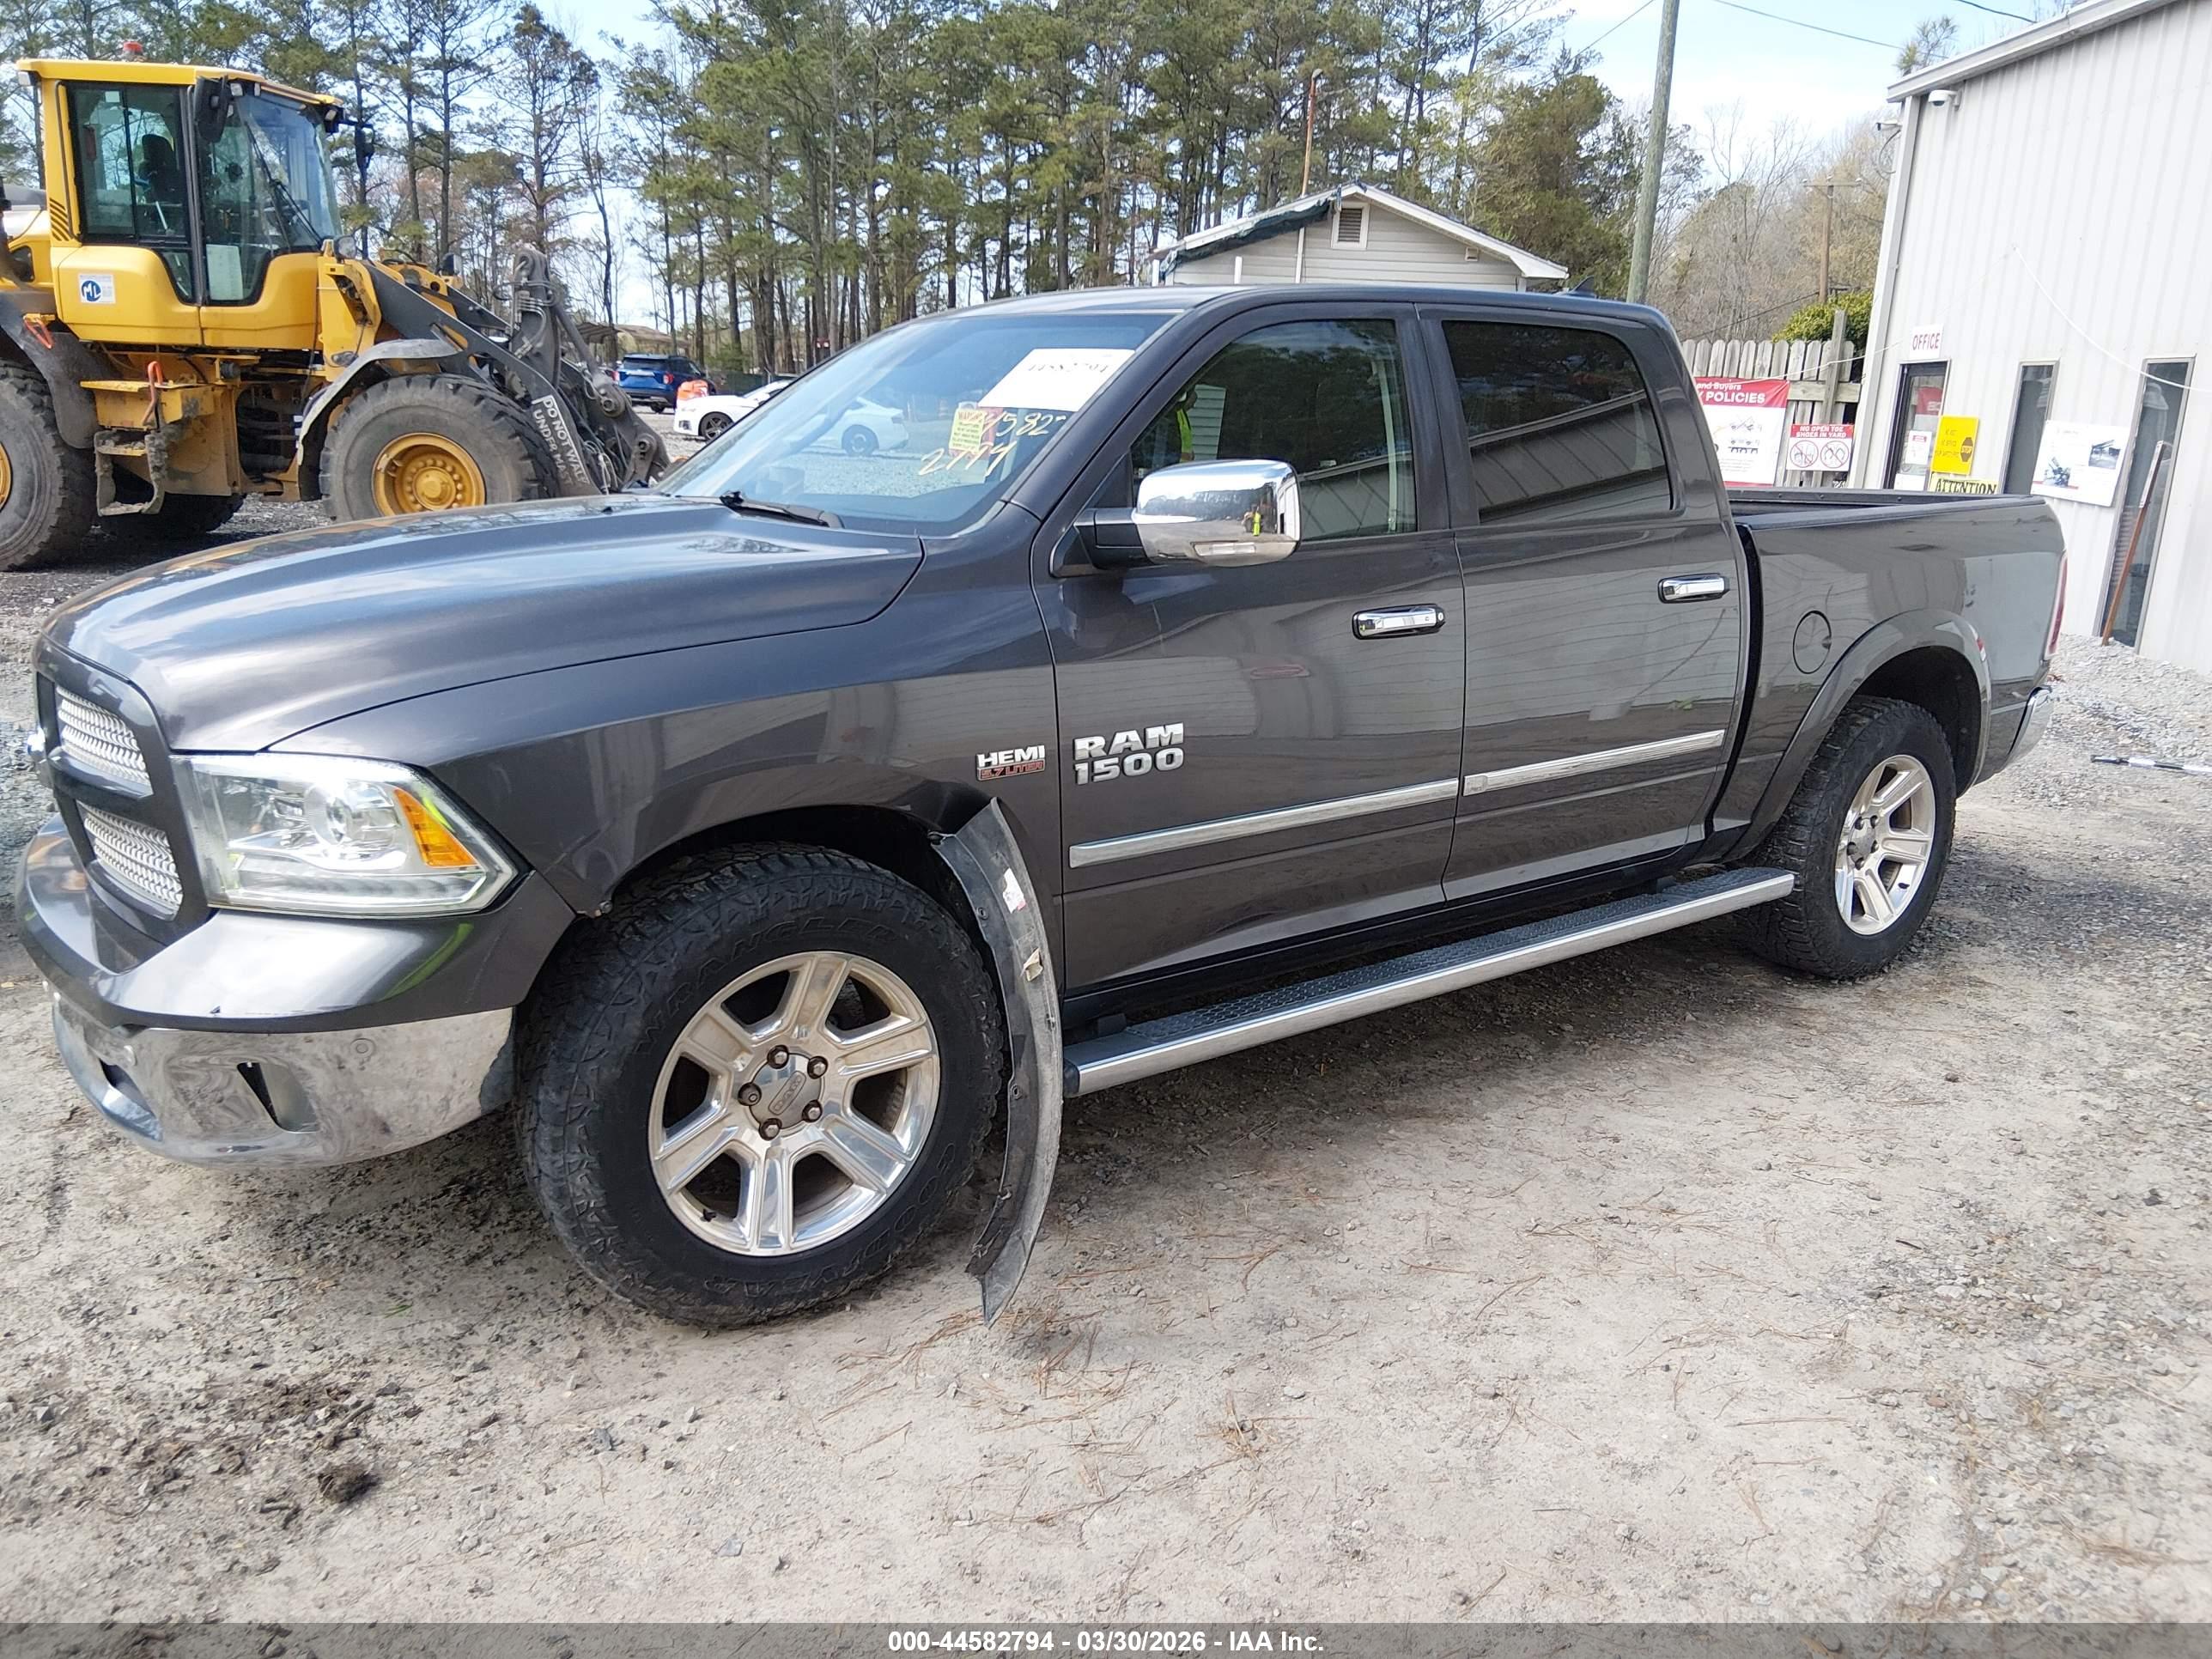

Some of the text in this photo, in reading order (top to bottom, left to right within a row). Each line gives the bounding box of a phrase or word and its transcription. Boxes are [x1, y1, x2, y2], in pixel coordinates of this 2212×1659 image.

[1912, 332, 1941, 351] OFFICE
[1713, 382, 1741, 392] Buyers
[1705, 391, 1765, 404] POLICIES
[532, 410, 558, 453] UNDER
[544, 399, 557, 418] DO
[553, 420, 571, 448] NOT
[1935, 478, 1997, 495] ATTENTION
[1074, 722, 1183, 760] RAM
[977, 745, 1045, 767] HEMI
[1075, 747, 1183, 785] 1500
[981, 768, 1003, 779] 5.7
